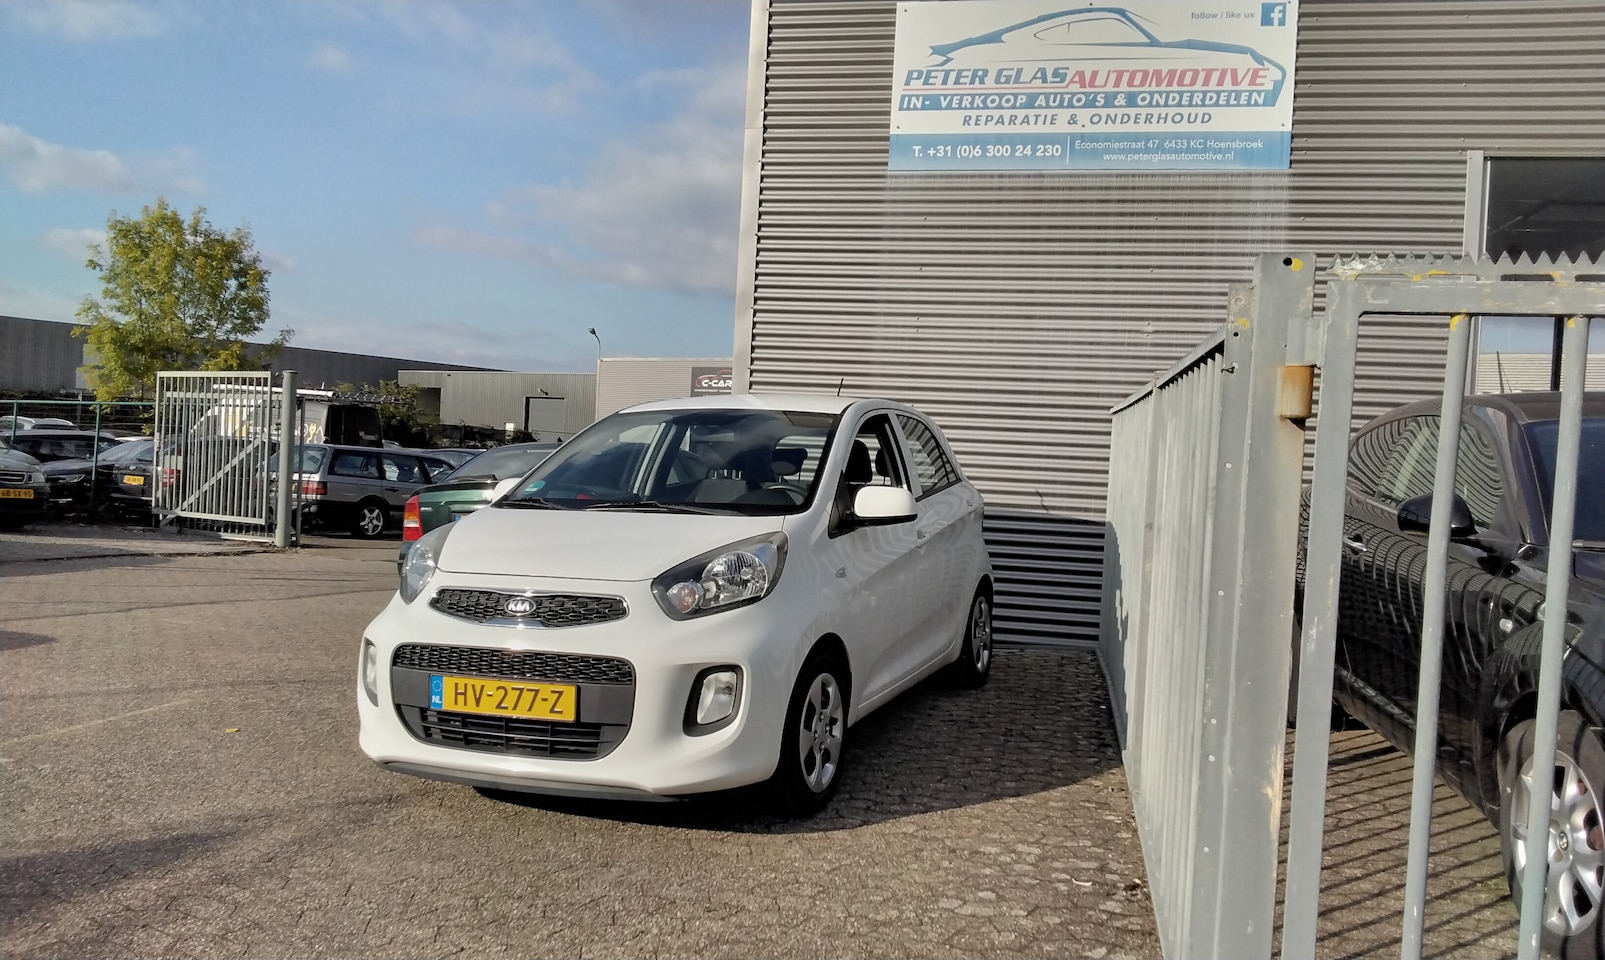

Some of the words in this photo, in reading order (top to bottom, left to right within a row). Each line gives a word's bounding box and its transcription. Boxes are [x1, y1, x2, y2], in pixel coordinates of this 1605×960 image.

[1191, 11, 1218, 19] follow
[1226, 11, 1242, 19] like
[903, 68, 989, 86] PETER
[903, 96, 930, 109] IN-
[940, 95, 1027, 108] VERKOOP
[1034, 94, 1105, 107] AUTO'S
[1114, 93, 1126, 106] &
[1137, 91, 1265, 105] ONDERDELEN
[962, 114, 1058, 126] REPARATIE
[1067, 114, 1079, 126] &
[1089, 112, 1212, 125] ONDERHOUD
[1075, 140, 1145, 149] Economiestraat
[1147, 140, 1159, 148] 47
[1164, 140, 1188, 148] 6433
[1190, 140, 1204, 148] KC
[1207, 139, 1264, 149] Hoensbroek
[913, 146, 923, 157] T.
[927, 145, 951, 157] +31
[956, 145, 981, 159] (0)6
[986, 145, 1011, 156] 300
[1015, 145, 1032, 156] 24
[1036, 144, 1061, 156] 230
[1103, 151, 1234, 162] www.peterglasautomotive.nl
[508, 600, 530, 611] KIA
[431, 694, 442, 704] NL
[454, 681, 564, 715] HV-277-Z
